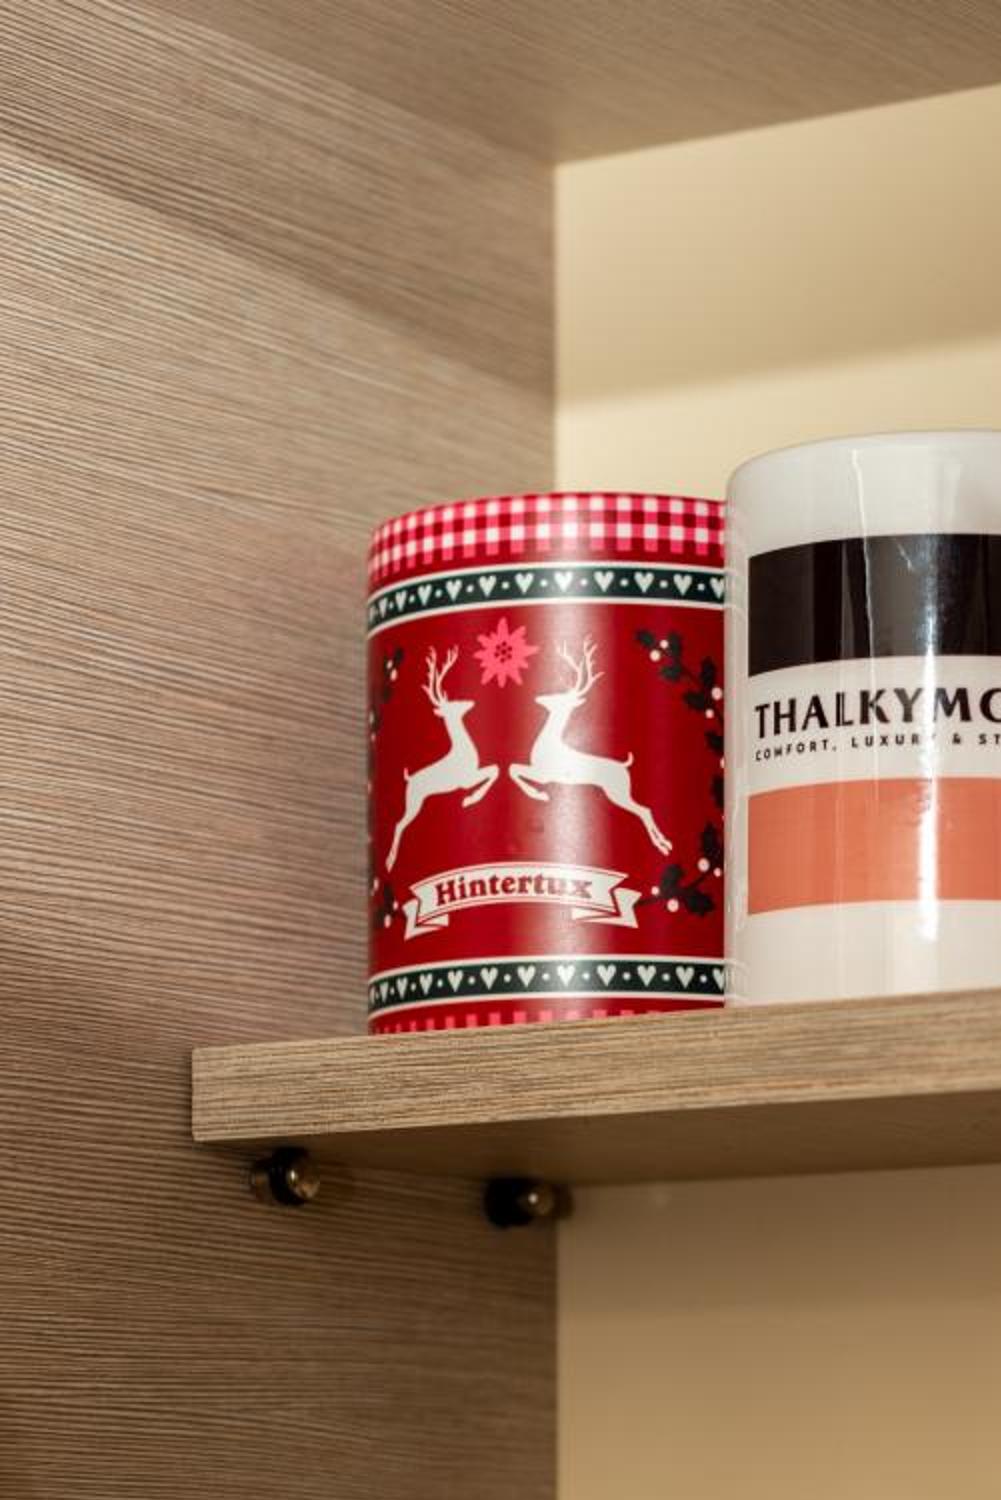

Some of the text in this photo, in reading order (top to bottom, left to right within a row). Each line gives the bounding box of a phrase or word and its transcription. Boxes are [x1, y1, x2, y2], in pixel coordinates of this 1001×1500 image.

[851, 733, 937, 749] LUXUR
[952, 732, 962, 745] &
[434, 872, 593, 907] Hintertux
